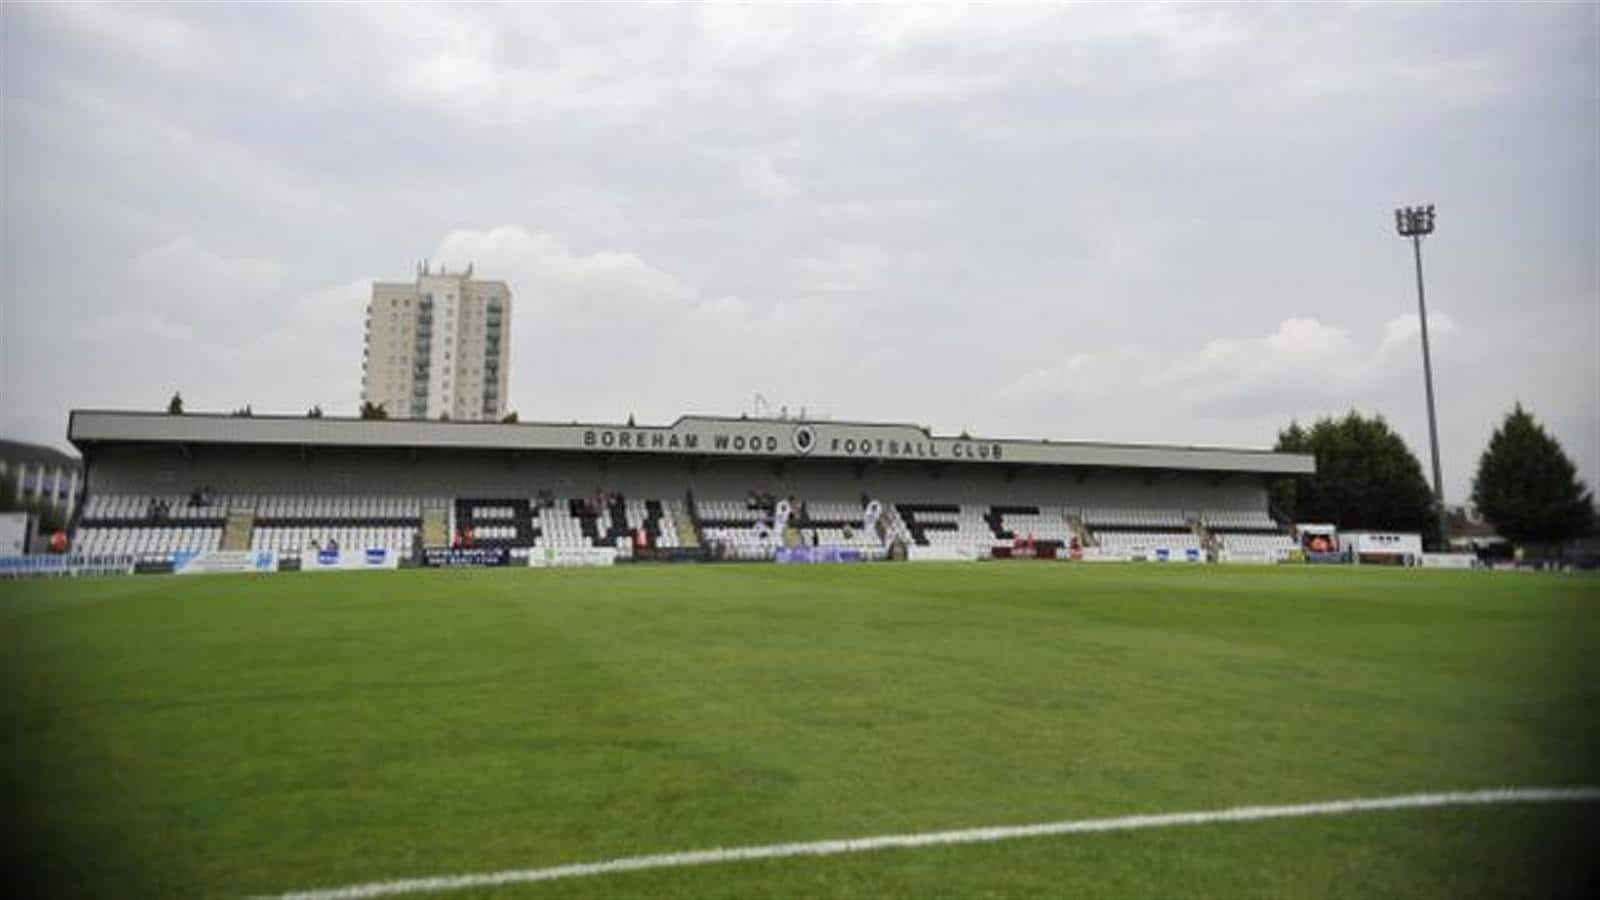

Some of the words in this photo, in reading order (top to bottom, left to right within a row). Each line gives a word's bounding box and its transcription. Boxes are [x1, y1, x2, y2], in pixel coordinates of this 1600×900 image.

[584, 431, 698, 448] BOREHAM
[715, 436, 778, 450] WOOD
[831, 438, 939, 457] FOOTBALL
[952, 443, 1003, 459] CLUB
